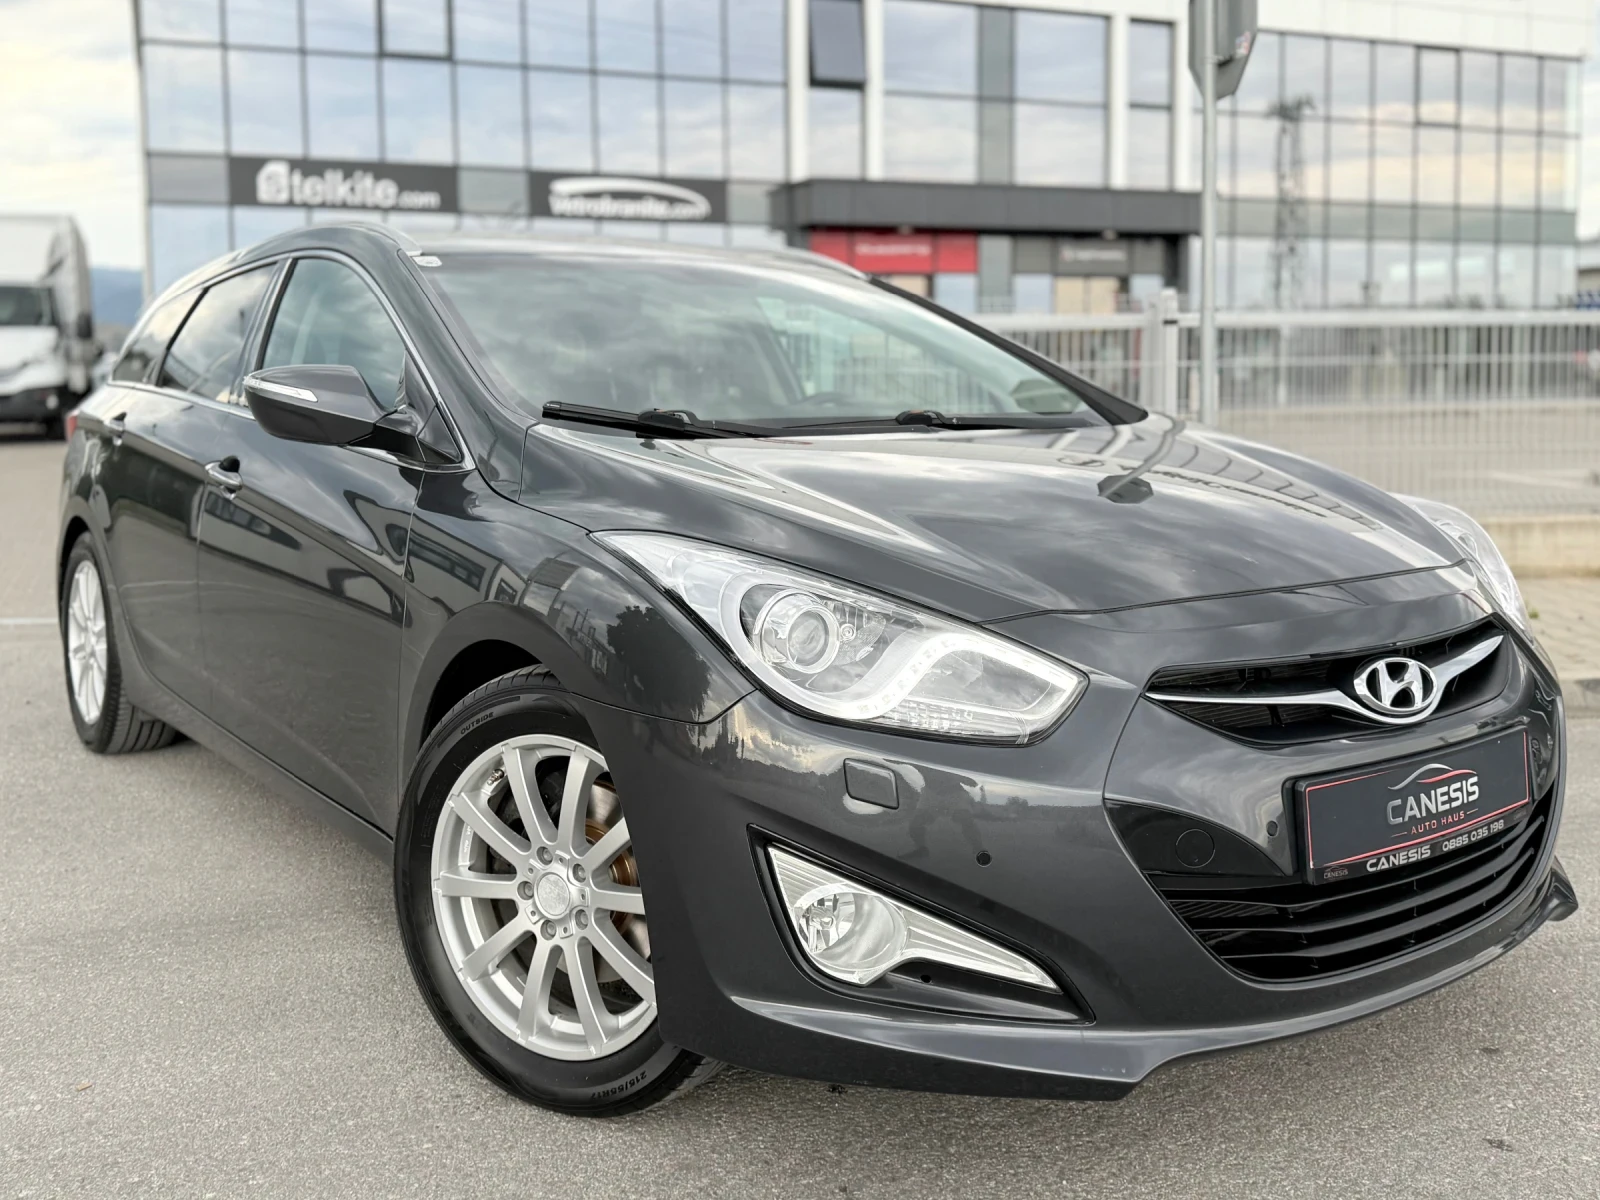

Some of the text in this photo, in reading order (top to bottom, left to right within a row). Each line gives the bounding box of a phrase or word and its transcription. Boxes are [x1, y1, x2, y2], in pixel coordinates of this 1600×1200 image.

[292, 168, 441, 208] telkite.com
[460, 711, 494, 735] OUTSIDE
[1386, 775, 1480, 826] CANESIS
[1411, 810, 1465, 835] AUTO HAUS
[1366, 819, 1505, 873] CANESIS 0885 035 198
[591, 1070, 647, 1100] 215/55R17
